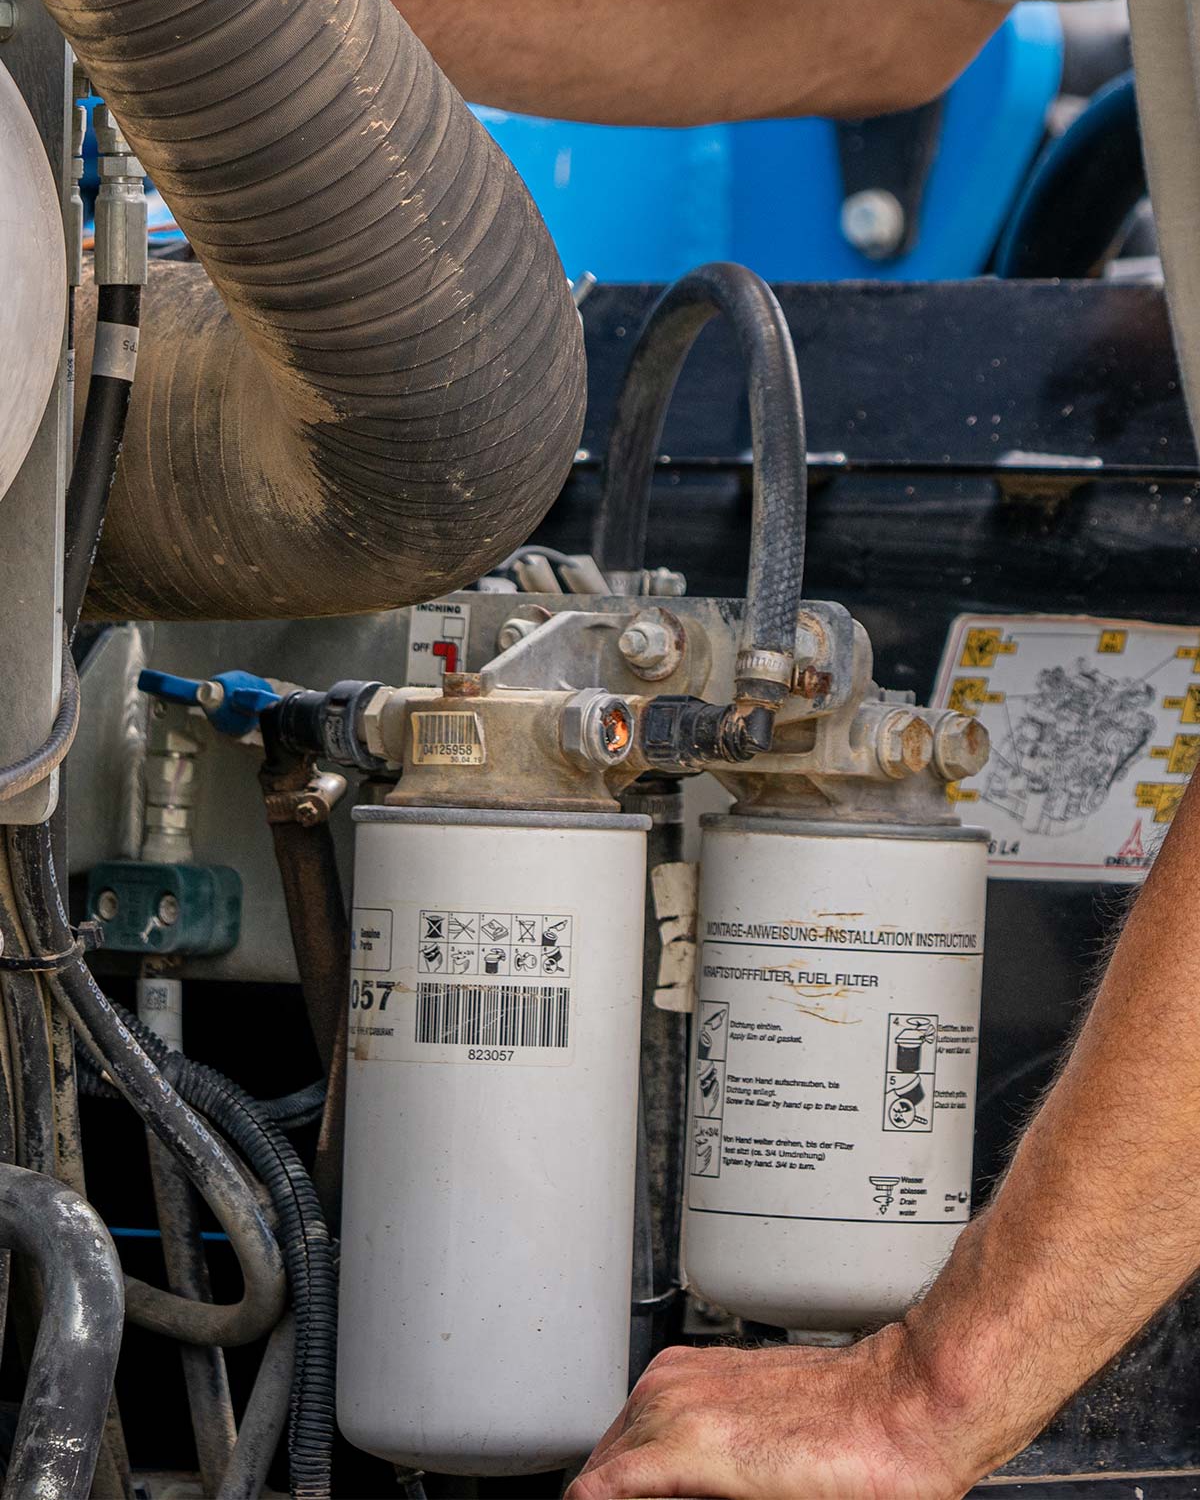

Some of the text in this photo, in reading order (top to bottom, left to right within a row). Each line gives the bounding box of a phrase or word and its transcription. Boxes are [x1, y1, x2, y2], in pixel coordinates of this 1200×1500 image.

[413, 642, 430, 652] OFF
[423, 744, 473, 756] 04125958
[916, 933, 977, 949] INSTRUCTIONS
[798, 972, 831, 985] FUEL
[835, 974, 879, 987] FILTER
[893, 1017, 900, 1025] 4
[468, 1048, 514, 1061] 823057
[755, 1077, 773, 1085] Hand
[890, 1076, 896, 1085] 5
[735, 1136, 752, 1144] Hand
